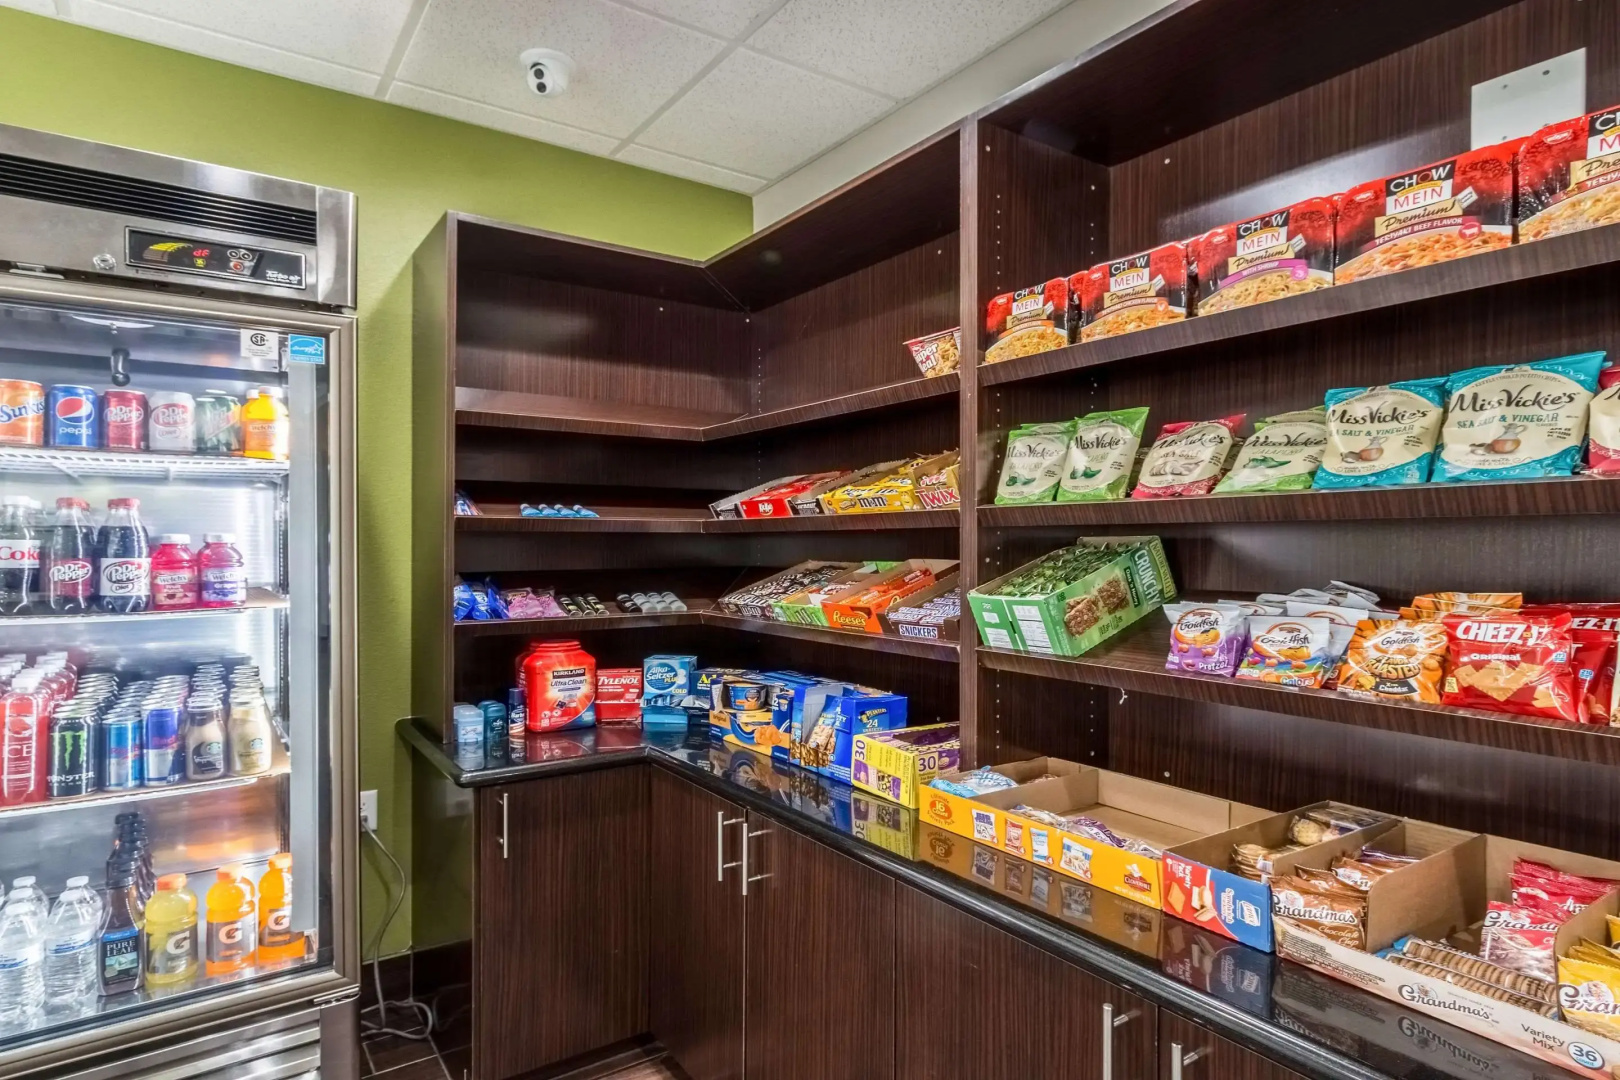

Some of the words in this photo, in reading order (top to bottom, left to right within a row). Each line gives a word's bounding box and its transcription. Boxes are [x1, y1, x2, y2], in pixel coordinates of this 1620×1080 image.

[1390, 164, 1451, 192] CHOW
[1394, 186, 1443, 210] MEIN
[1381, 199, 1456, 230] Premium
[1240, 211, 1287, 236] CHOW
[1375, 226, 1411, 246] TERIYAKI
[1414, 222, 1432, 232] BEEF
[1433, 218, 1463, 227] FLAVOR
[1242, 232, 1280, 252] MEIN
[1111, 256, 1148, 274] CHOW
[1233, 244, 1290, 269] Premium
[1114, 272, 1144, 289] MEIN
[1014, 284, 1044, 300] CHOW
[1107, 284, 1152, 303] Premium
[1016, 299, 1040, 312] MEIN
[1010, 308, 1045, 327] Premium
[915, 343, 938, 361] uper
[1450, 392, 1501, 414] Miss
[1500, 384, 1577, 411] Vickie's
[0, 399, 45, 422] Sunkis
[1328, 409, 1368, 425] Miss
[1365, 401, 1431, 425] Vickie's
[1457, 420, 1475, 429] SEA
[1498, 414, 1507, 423] &
[1512, 413, 1559, 423] VINEGAR
[59, 426, 92, 435] pepsi
[1341, 429, 1364, 437] SALT
[1376, 424, 1414, 436] VINEGAR
[1094, 431, 1127, 450] Vickie's
[52, 566, 89, 581] Pepper
[64, 564, 81, 572] Dr
[124, 564, 139, 572] Dr
[1134, 549, 1161, 605] CRUNCHY
[900, 624, 937, 639] SNICKERS
[1180, 617, 1219, 631] Goldfish
[1381, 636, 1420, 646] Goldfish
[553, 669, 585, 677] KIRKLAND
[597, 676, 640, 685] TYLENOL
[646, 672, 676, 681] Seltzer
[567, 679, 587, 687] Clean
[867, 719, 878, 728] 24
[918, 755, 937, 772] 30
[932, 807, 949, 817] Count
[935, 801, 945, 812] 16
[1183, 865, 1192, 889] Variety
[1272, 894, 1357, 924] Grandma's
[218, 921, 242, 944] G
[1318, 925, 1359, 938] Chocolate
[106, 940, 135, 951] PURE
[166, 931, 190, 954] G
[106, 948, 133, 958] LEAF
[1397, 984, 1490, 1020] Grandma's
[1521, 1023, 1565, 1047] Variety
[1533, 1037, 1555, 1052] Mix
[1573, 1044, 1598, 1062] 36
